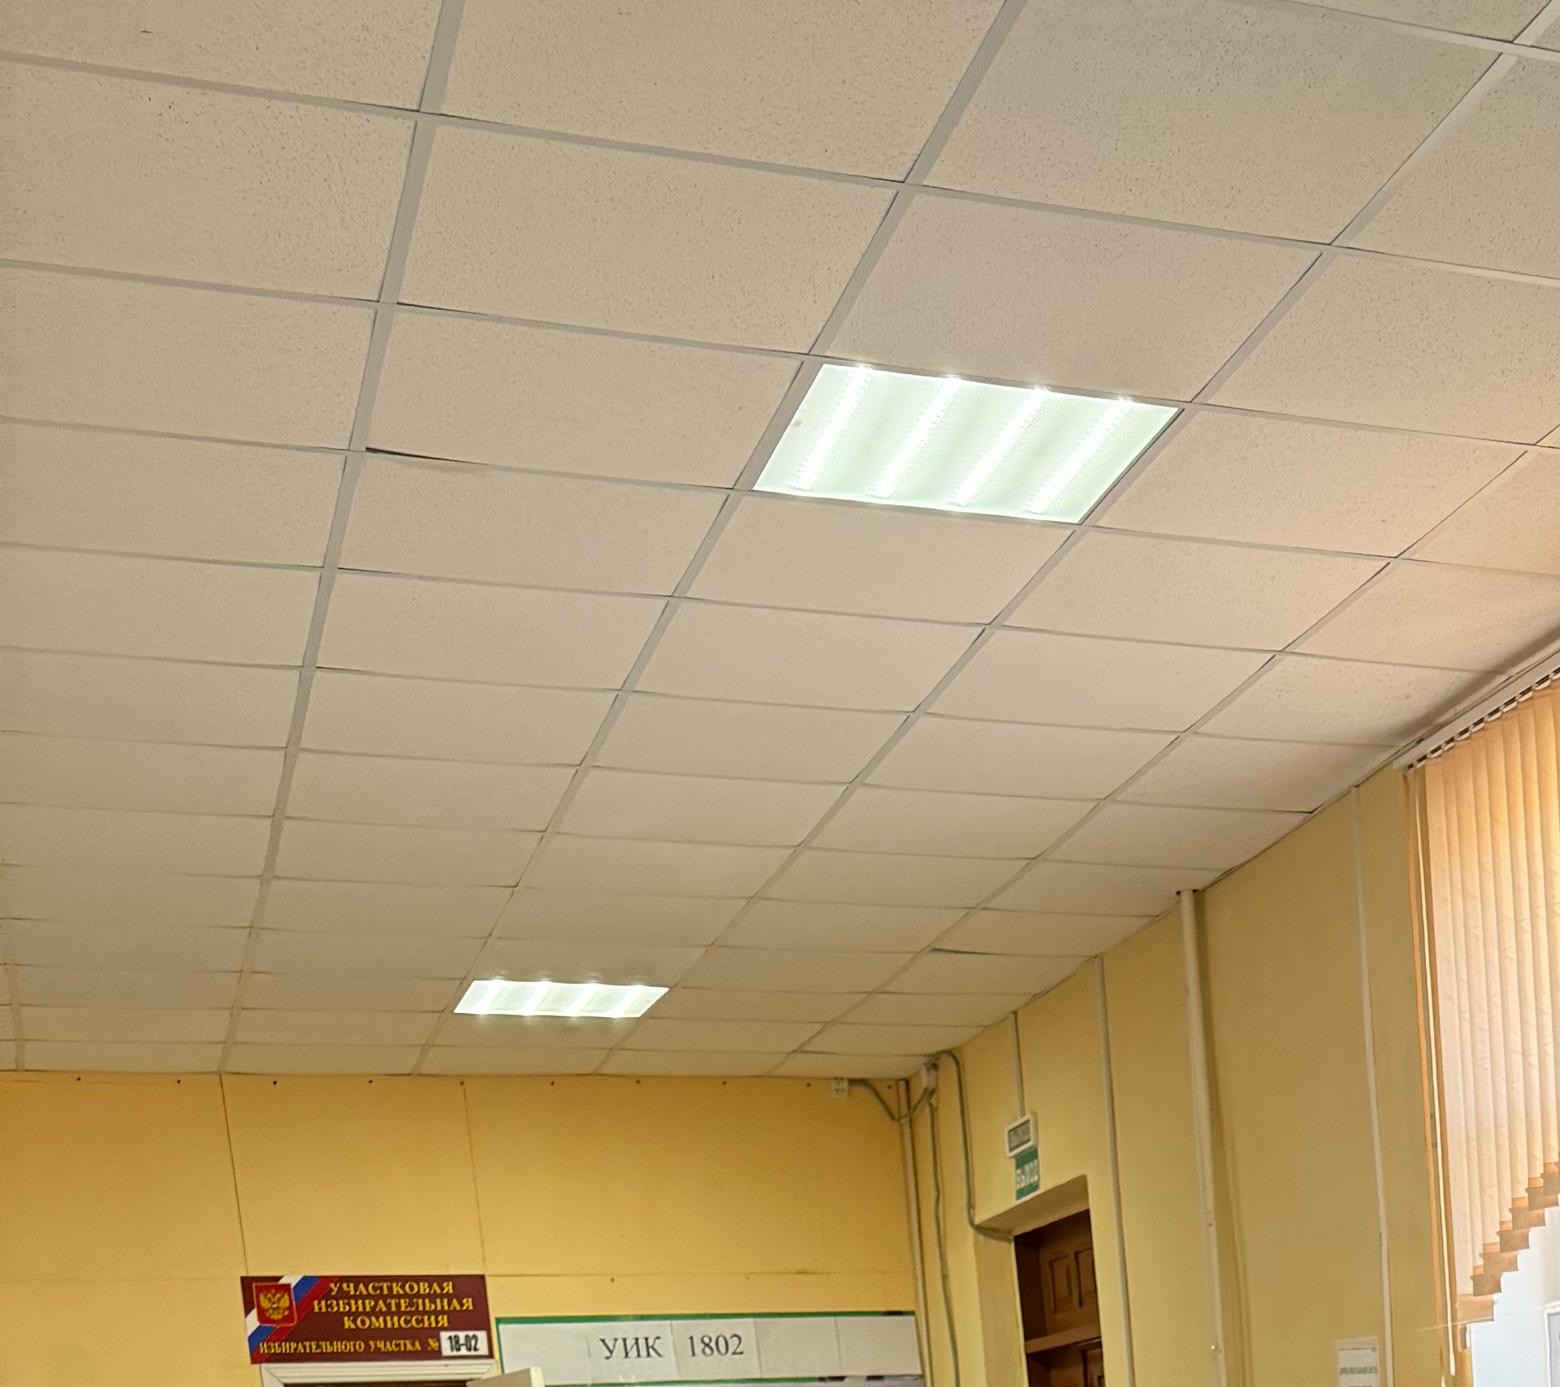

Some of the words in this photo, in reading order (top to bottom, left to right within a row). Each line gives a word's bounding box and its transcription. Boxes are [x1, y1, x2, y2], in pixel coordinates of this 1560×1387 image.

[329, 1281, 454, 1295] УЧАСТКОВАЯ
[313, 1297, 474, 1313] ИЗБИРАТЕЛЬНАЯ
[343, 1315, 449, 1330] КОМИССИЯ
[258, 1340, 365, 1355] ИЗБИРАТЕЛЬНОГО
[369, 1339, 421, 1352] УЧАСТКА
[447, 1334, 479, 1353] 18-02
[600, 1334, 664, 1360] УИК
[687, 1333, 745, 1358] 1802
